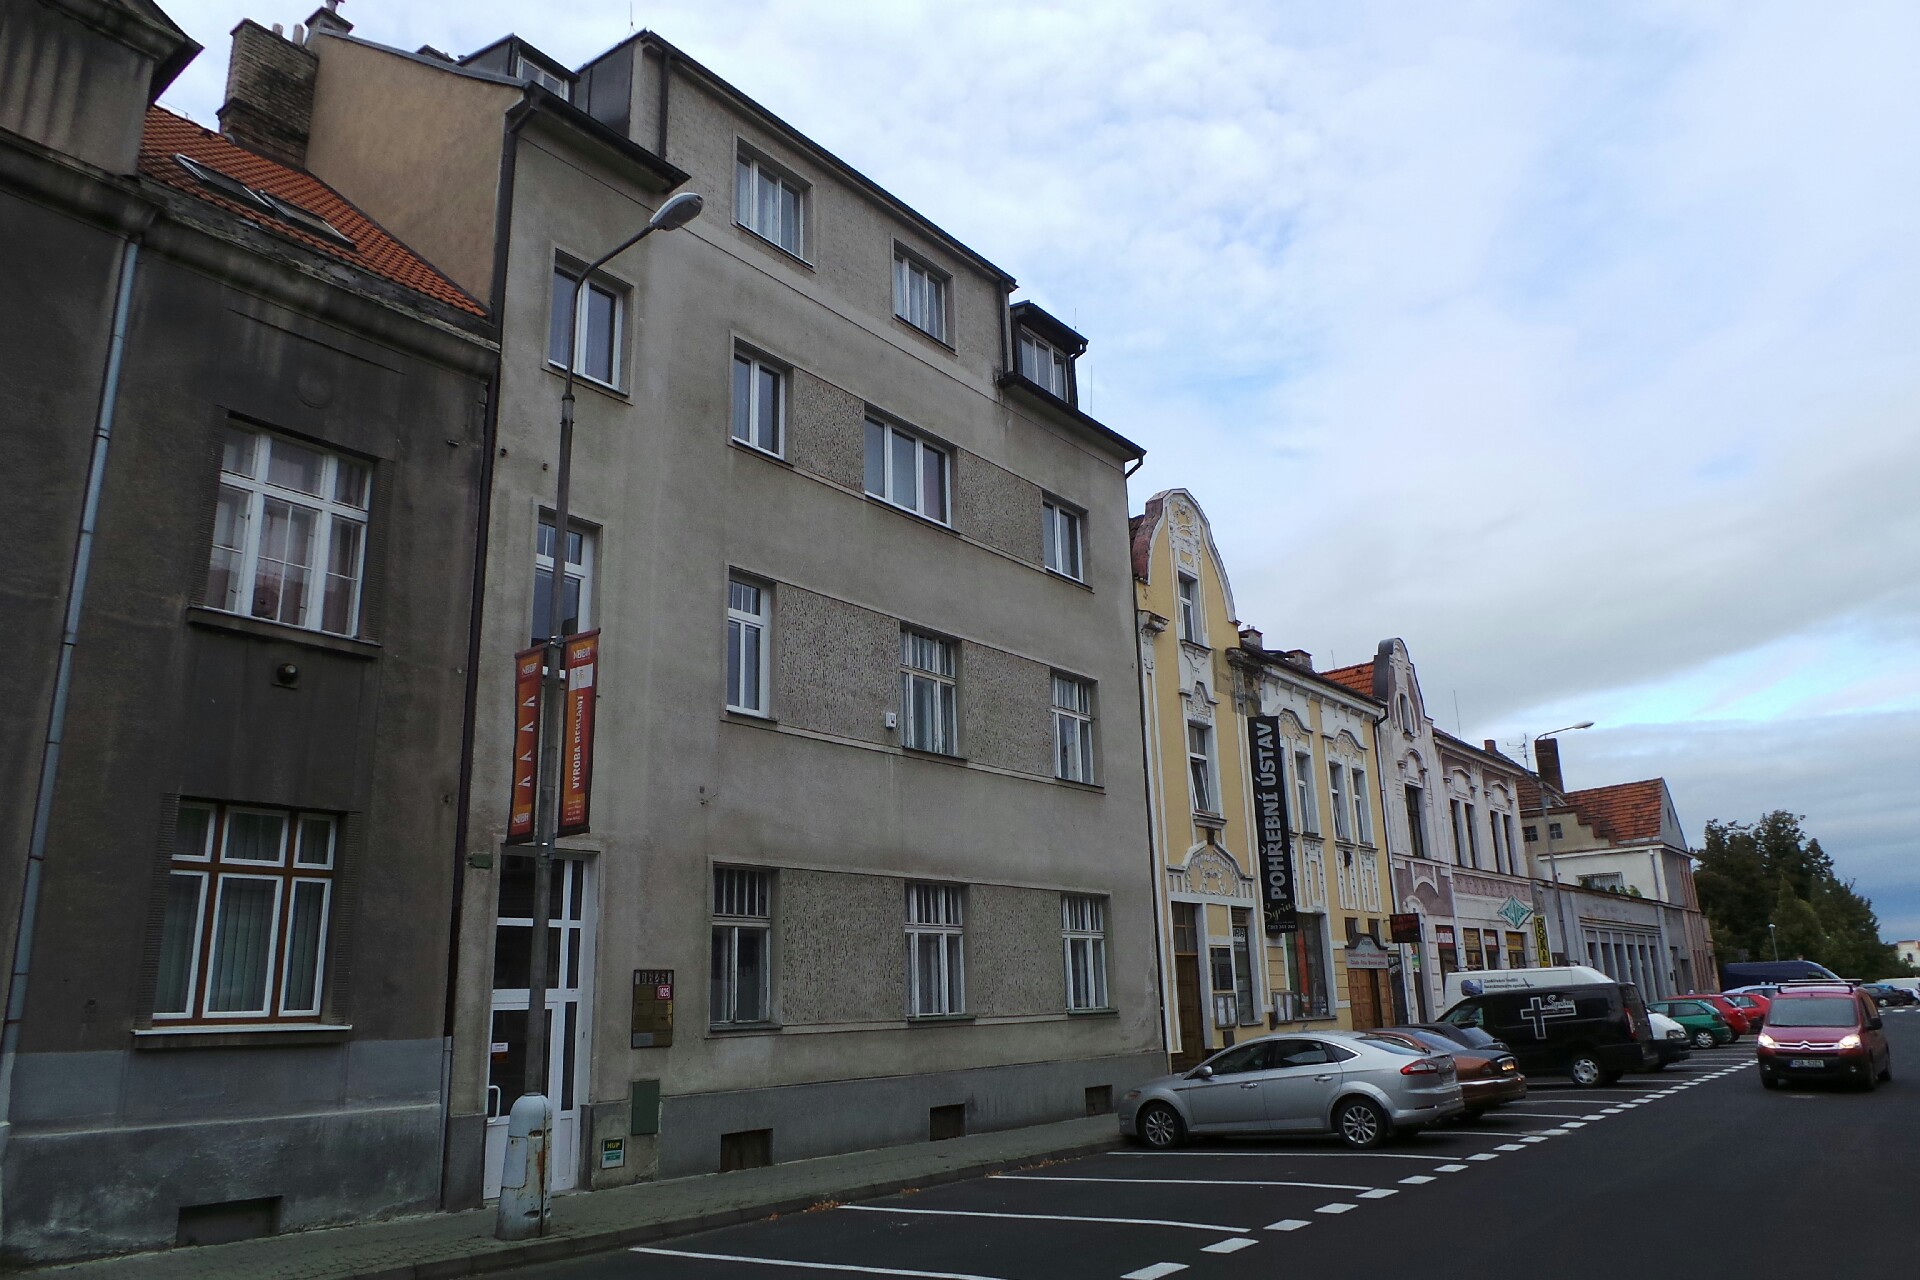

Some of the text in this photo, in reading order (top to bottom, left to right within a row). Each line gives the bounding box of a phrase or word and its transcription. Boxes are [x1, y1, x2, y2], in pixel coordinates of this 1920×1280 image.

[1255, 722, 1277, 787] ÚSTAV
[1258, 792, 1288, 900] POHŘEBNÍ
[1536, 917, 1548, 962] DROGERIE
